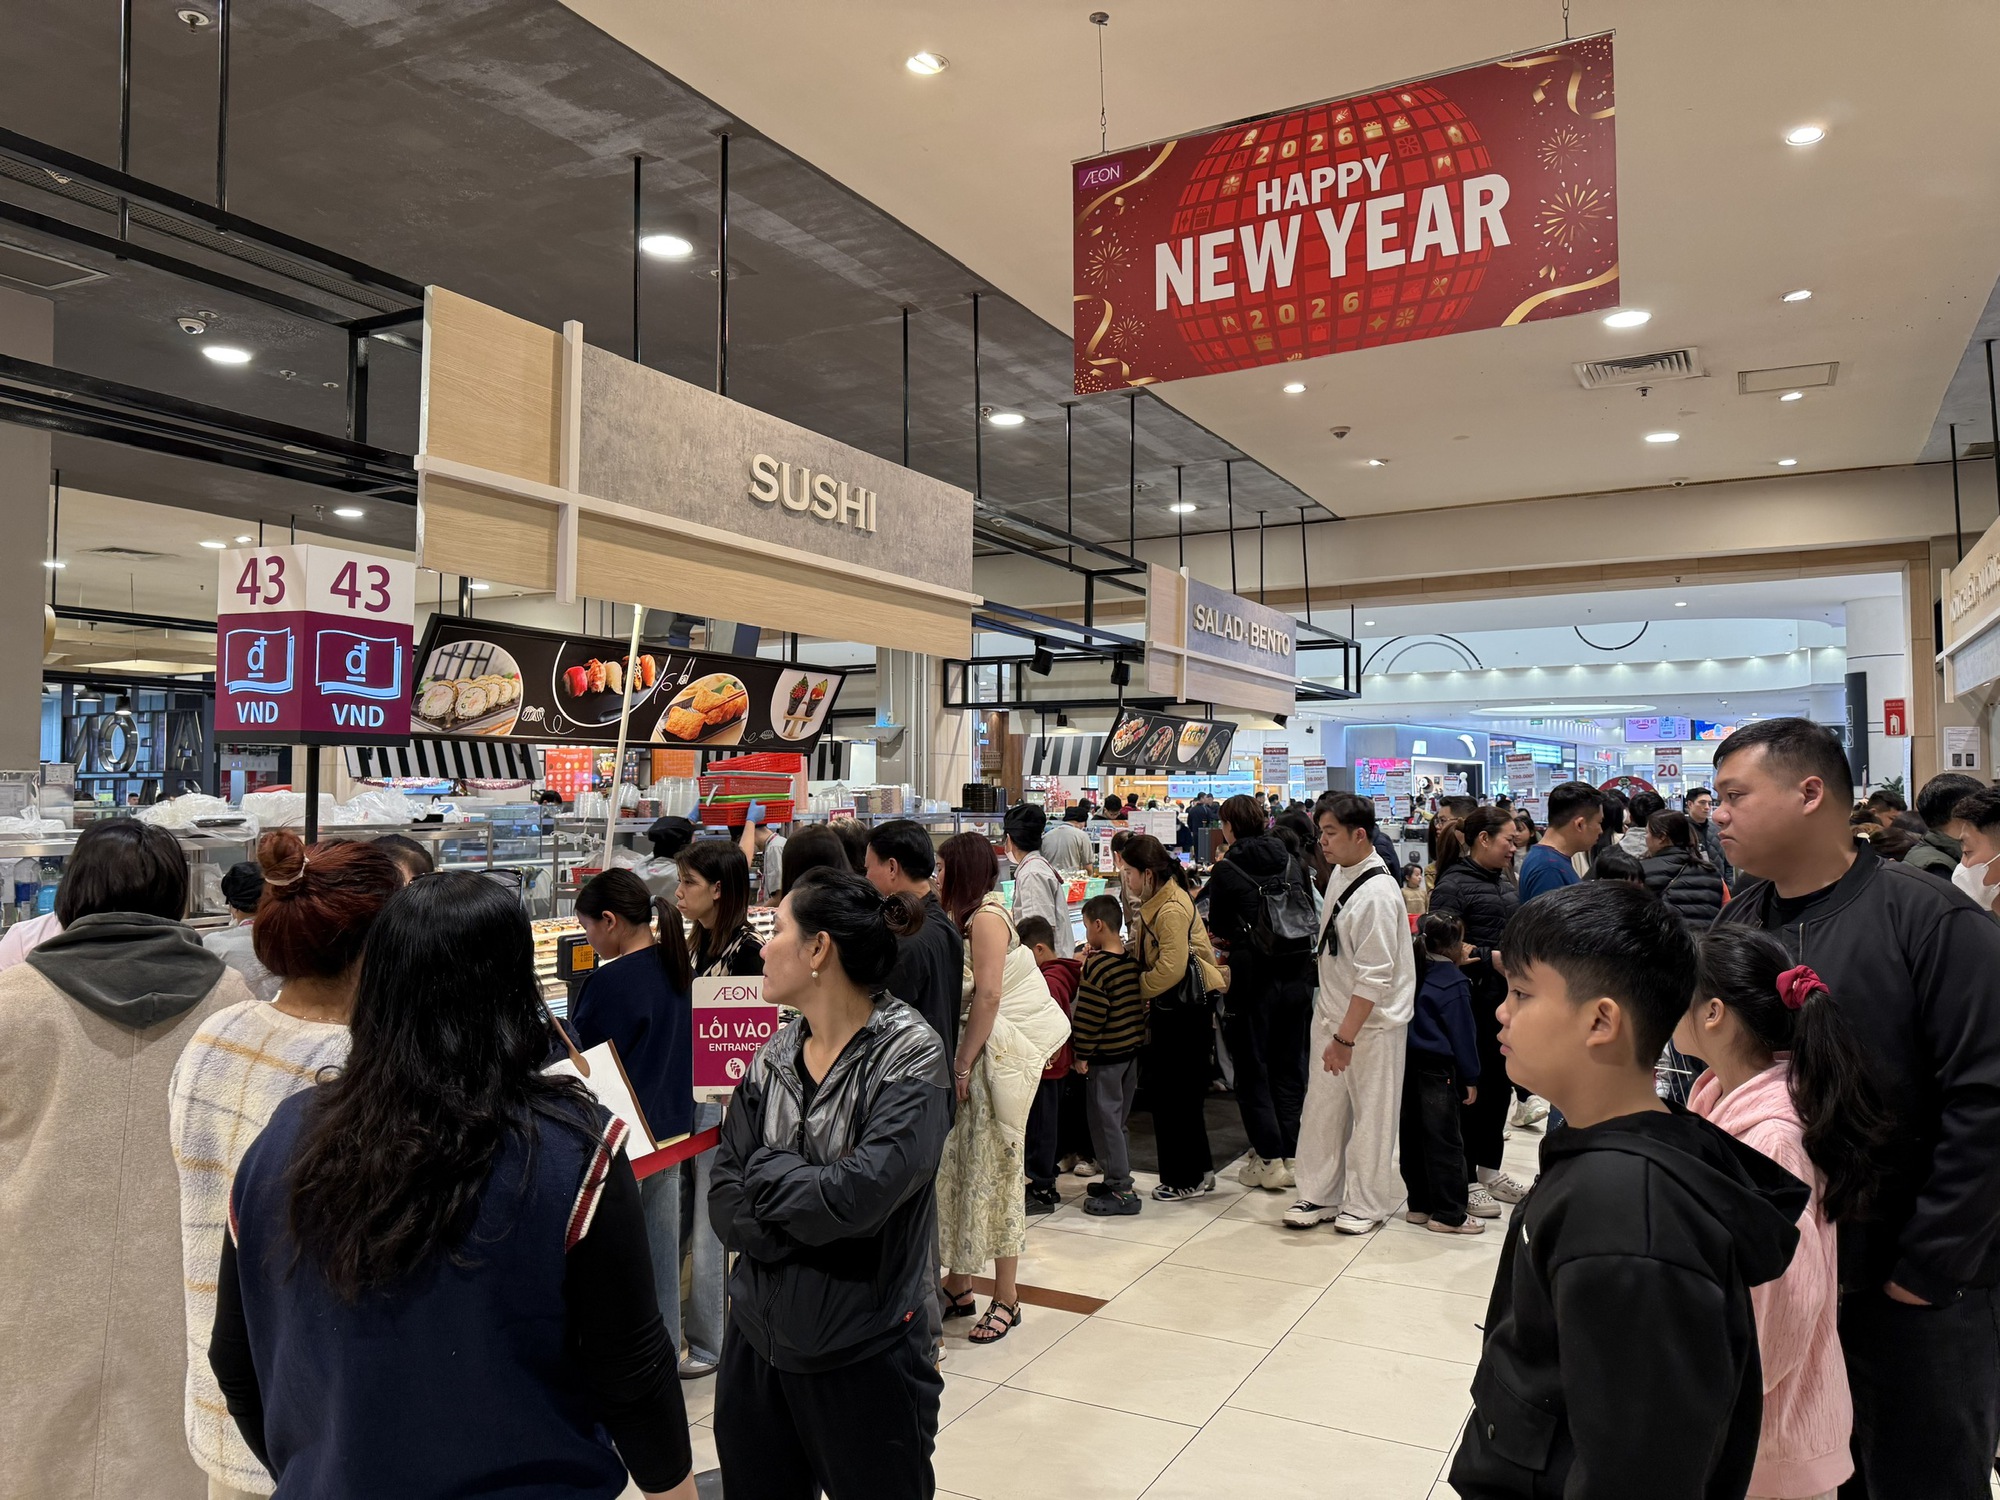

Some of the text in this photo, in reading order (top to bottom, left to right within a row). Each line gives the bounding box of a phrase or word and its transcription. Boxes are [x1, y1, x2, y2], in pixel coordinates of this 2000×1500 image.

[1257, 154, 1389, 215] HAPPY
[1156, 174, 1511, 311] NEW YEAR
[748, 453, 877, 533] SUSHI
[236, 556, 286, 606] 43
[330, 561, 391, 612] 43
[1194, 604, 1291, 656] SALAD BENTO
[236, 701, 279, 724] VND
[331, 703, 385, 728] VND
[699, 1016, 771, 1039] LỐI VÀO
